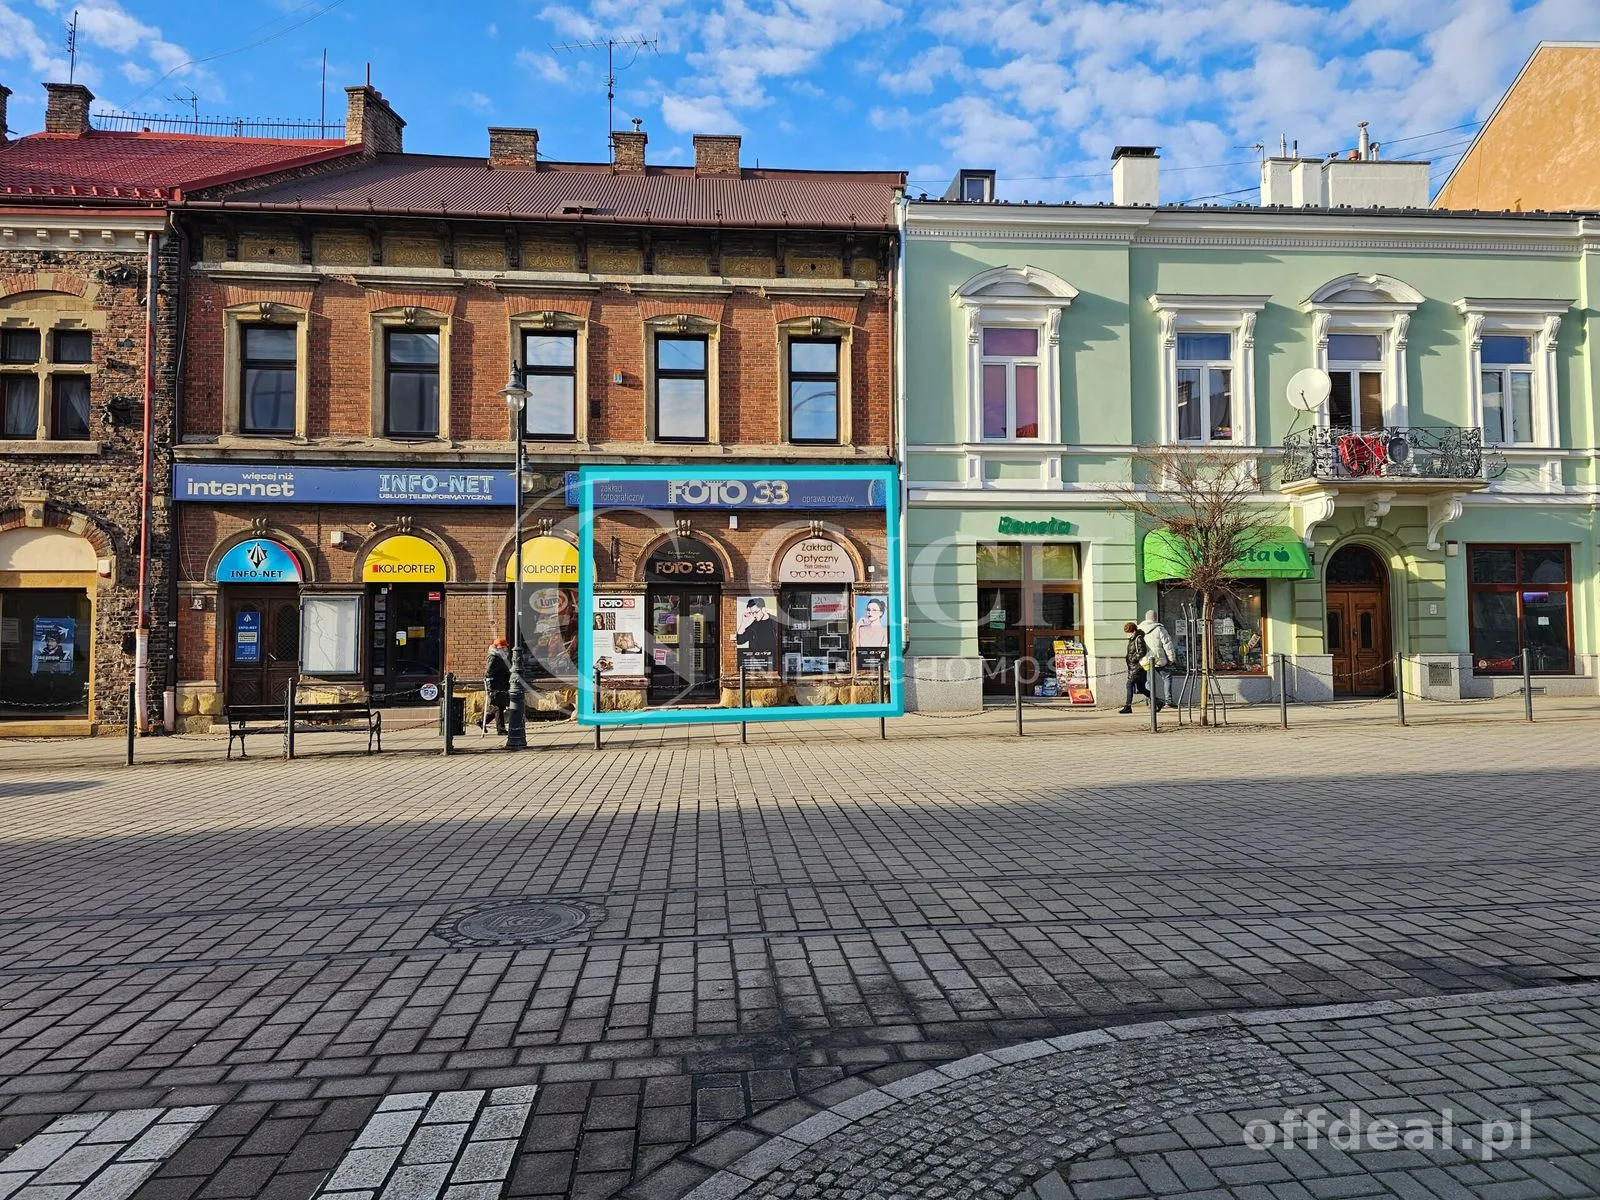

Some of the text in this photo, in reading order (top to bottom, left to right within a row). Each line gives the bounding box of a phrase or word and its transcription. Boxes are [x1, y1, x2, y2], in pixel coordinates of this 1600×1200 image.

[242, 472, 294, 481] więcej niż
[187, 478, 295, 496] internet
[379, 474, 495, 493] INFO-NET
[600, 484, 622, 493] zakład
[667, 480, 790, 504] FOTO 33
[600, 493, 645, 503] fotograficzny
[802, 494, 855, 504] oprawa obrazów
[998, 516, 1070, 535] Reneta
[801, 542, 833, 552] Zakład
[795, 554, 839, 565] Optyczny
[378, 564, 436, 574] KOLPORTER
[656, 561, 715, 574] FOTO 33
[230, 570, 283, 578] INFO-NET
[600, 599, 623, 608] FOTO
